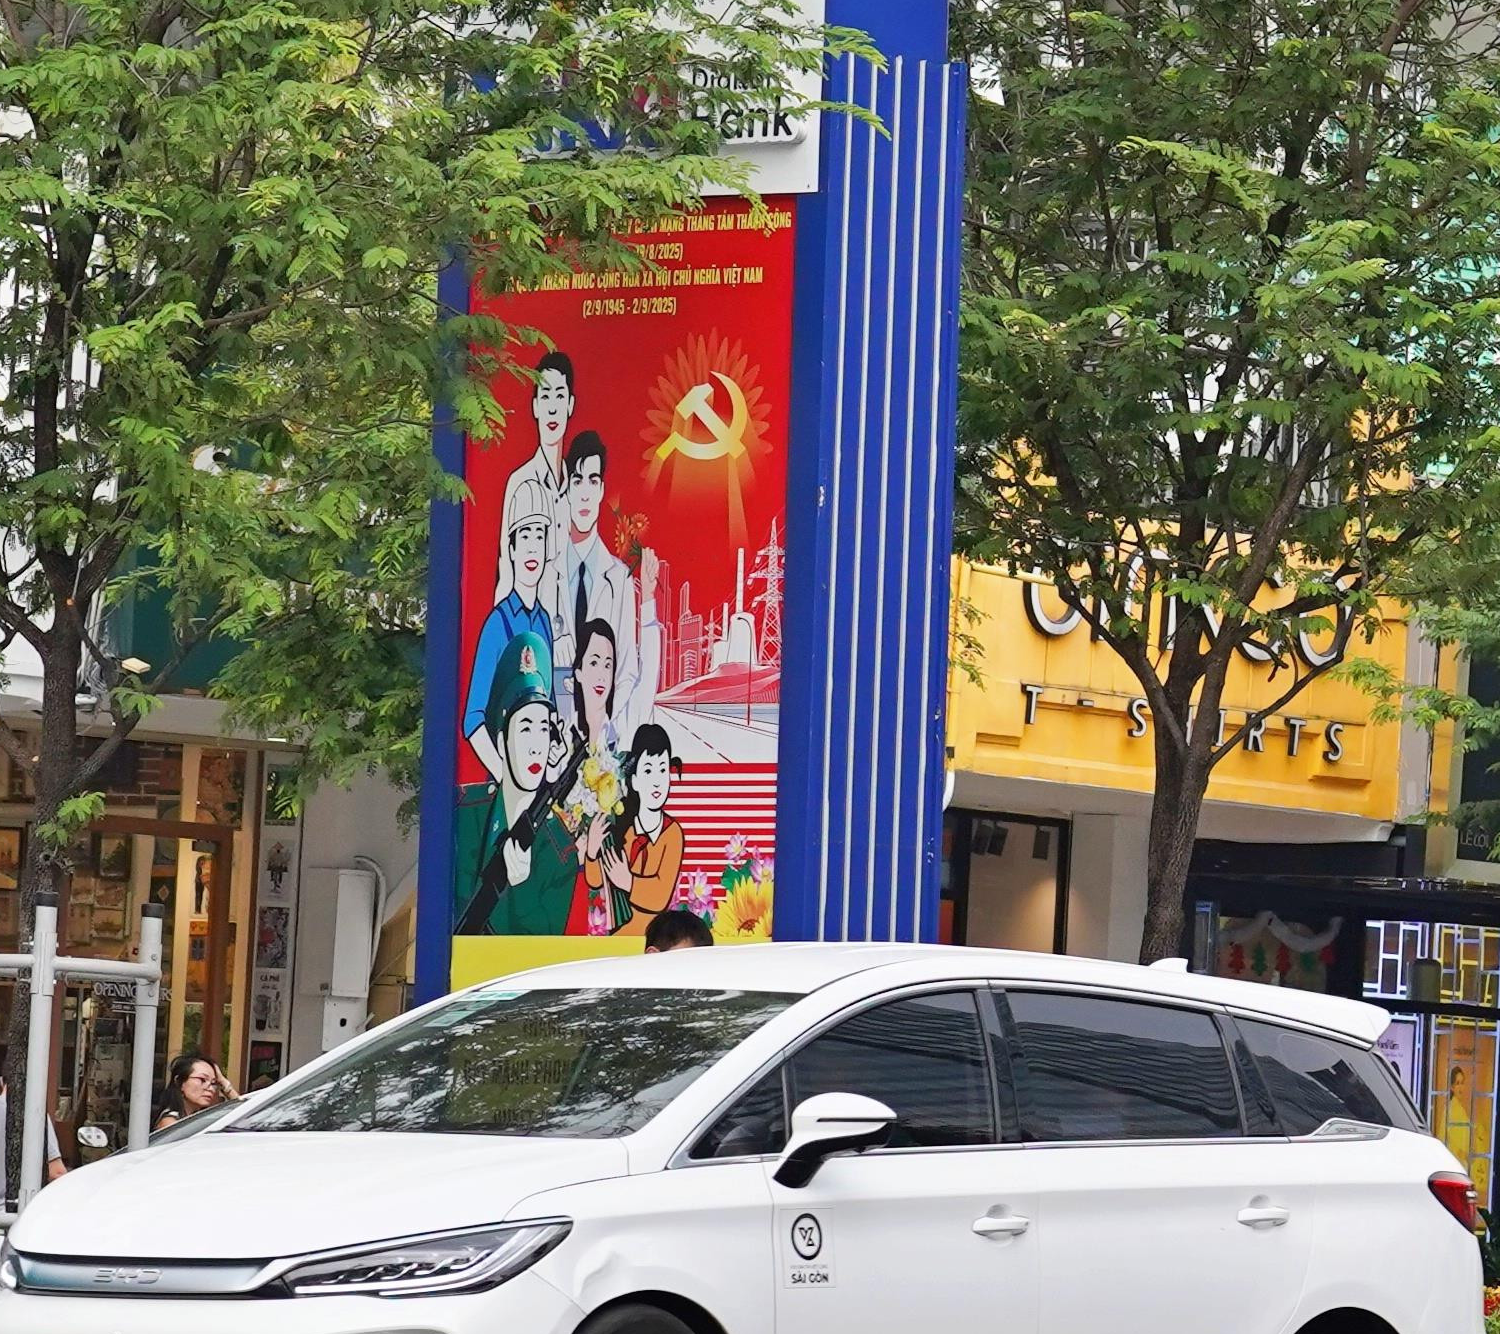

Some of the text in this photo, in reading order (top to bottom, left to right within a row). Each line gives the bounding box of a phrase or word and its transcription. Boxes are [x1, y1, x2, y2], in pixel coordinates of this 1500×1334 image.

[635, 243, 684, 261] 9/8/2025)
[673, 264, 692, 286] CHỦ
[694, 263, 720, 285] NGHĨA
[723, 264, 741, 287] VIỆT
[744, 267, 763, 284] NAM
[582, 298, 624, 318] (2/9/1945
[632, 297, 677, 316] 2/9/2025)
[93, 1267, 163, 1284] BYD
